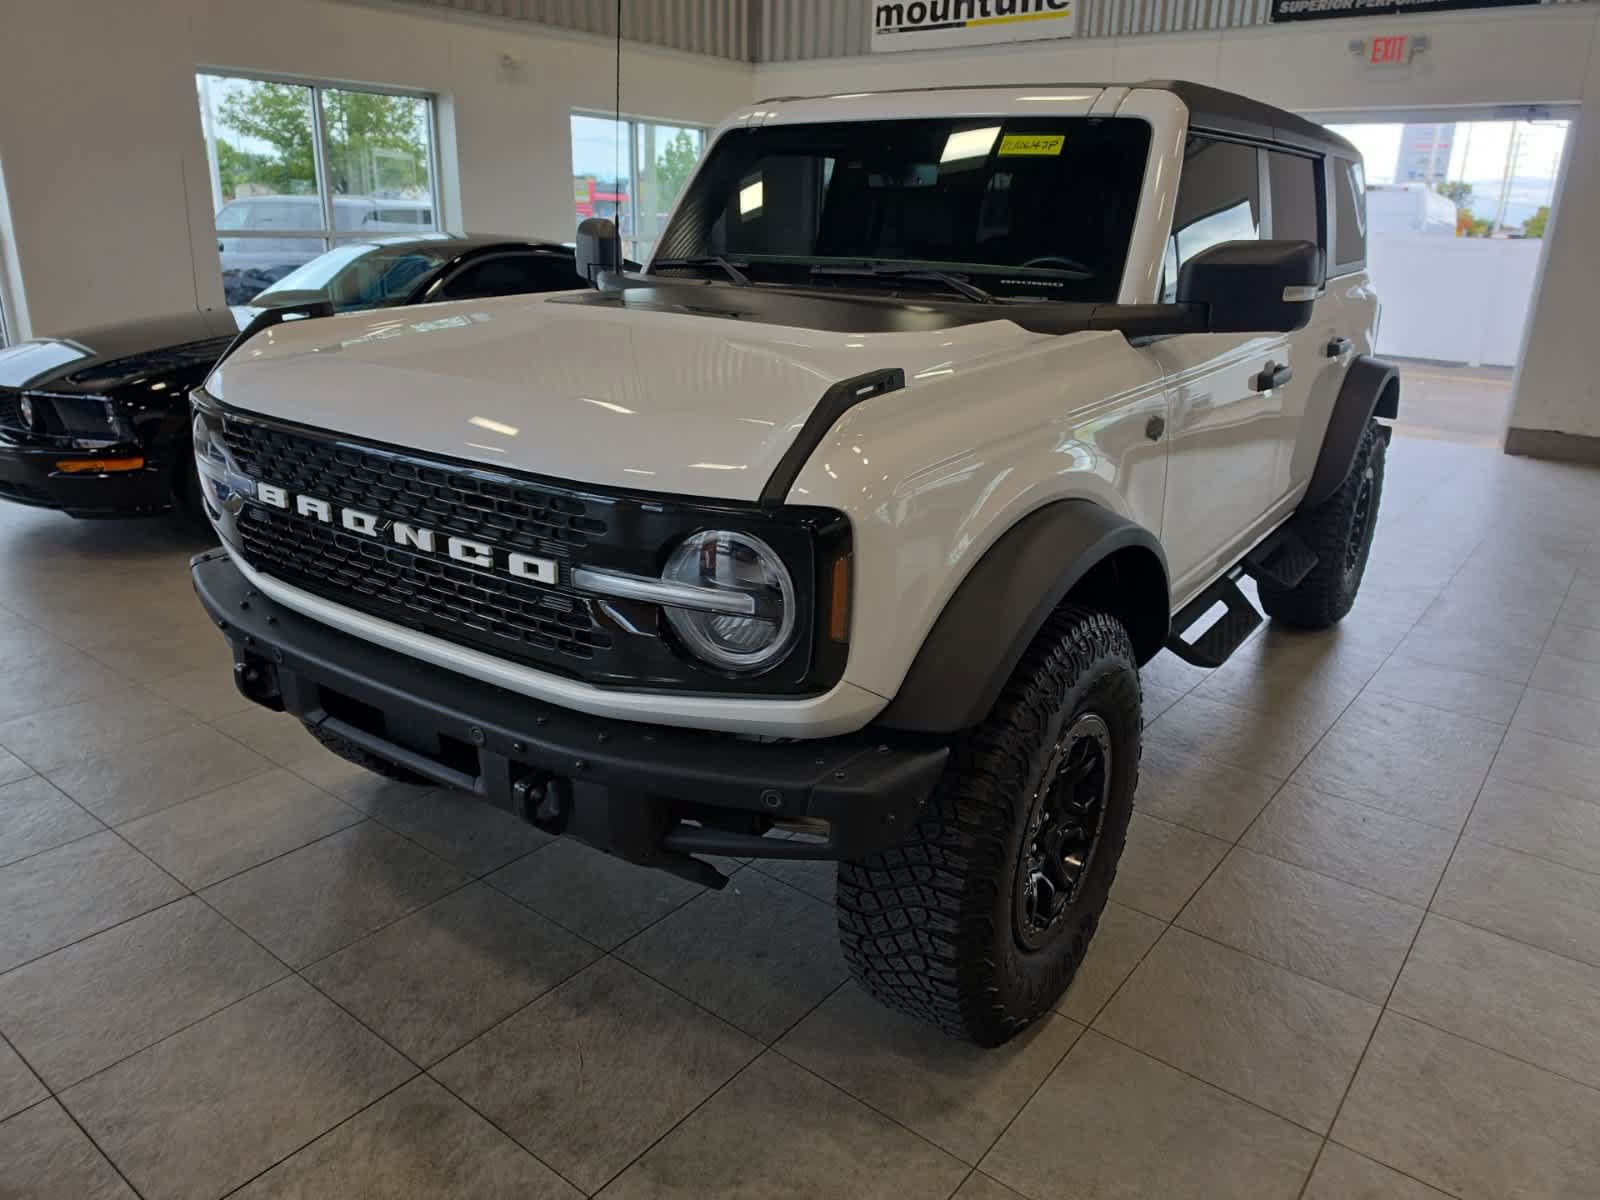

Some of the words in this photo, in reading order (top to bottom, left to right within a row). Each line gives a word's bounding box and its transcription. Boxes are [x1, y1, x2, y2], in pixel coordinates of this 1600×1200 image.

[1279, 0, 1352, 13] SUPERIOR
[1370, 36, 1408, 64] EXIT
[258, 482, 559, 585] BRONCO
